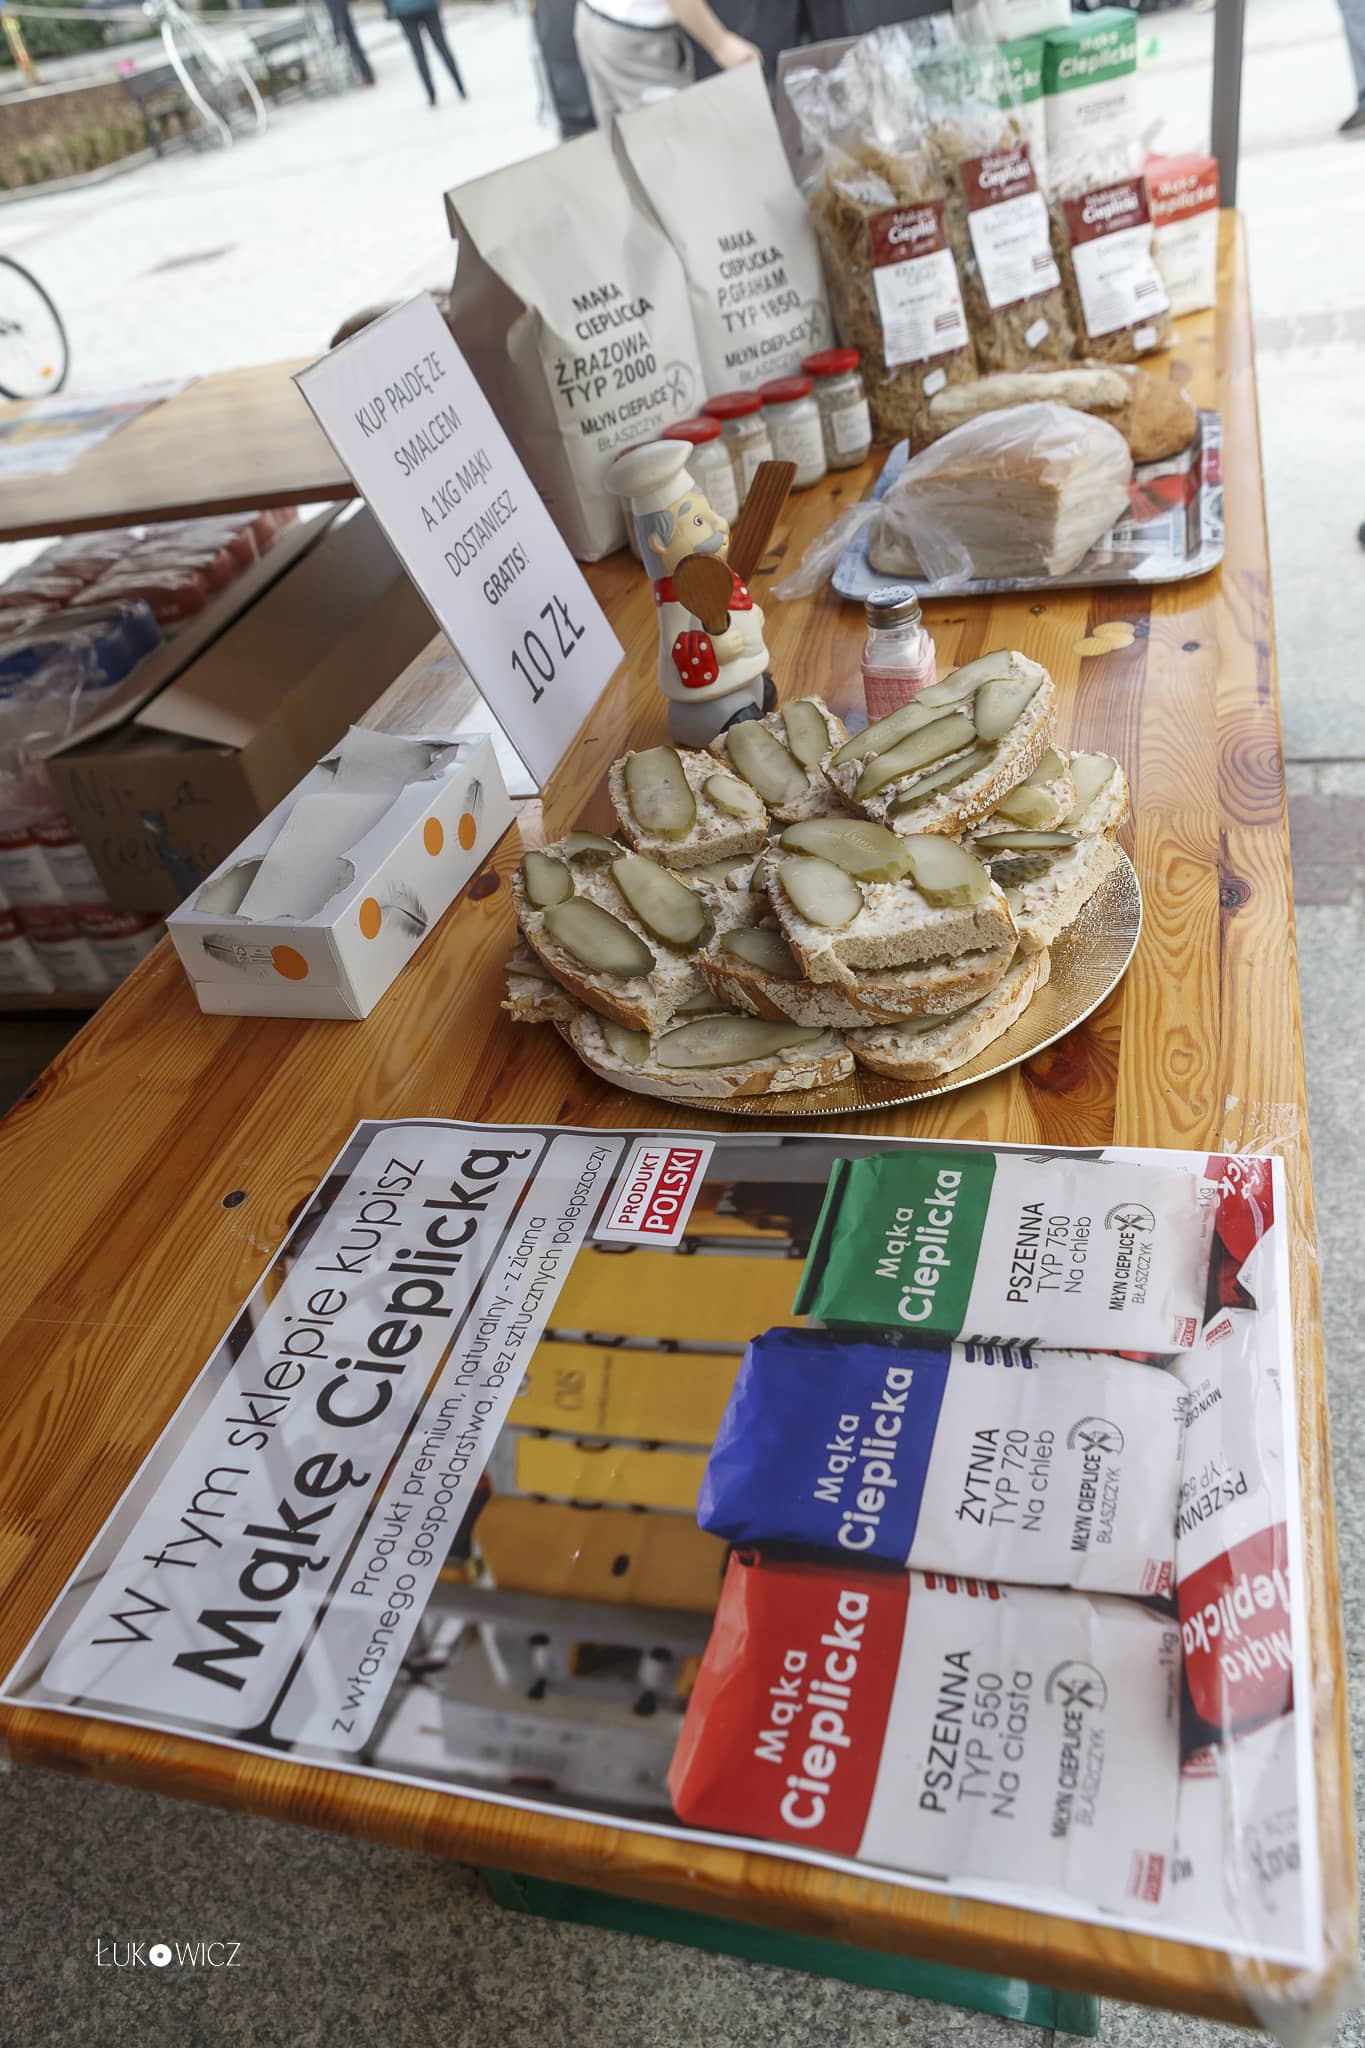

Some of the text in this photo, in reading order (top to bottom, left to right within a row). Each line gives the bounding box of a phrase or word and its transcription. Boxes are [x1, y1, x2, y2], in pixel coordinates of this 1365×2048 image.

[575, 297, 655, 341] CIEPLICKA
[721, 306, 757, 333] TYP
[354, 351, 447, 438] KUP PAJDĘ ZE
[559, 354, 656, 408] TYP 2000
[580, 386, 669, 435] MŁYN CIEPLICE
[393, 405, 462, 477] SMALCEM
[420, 448, 494, 532] A 1KG MĄKI
[444, 489, 518, 577] DOSTANIESZ
[482, 542, 530, 606] GRATIS!
[511, 595, 585, 704] 10 ZŁ
[619, 1152, 661, 1225] PRODUKT
[645, 1149, 698, 1231] POLSKI
[504, 1271, 521, 1282] z
[508, 1216, 547, 1270] ziarna
[875, 1207, 914, 1279] Mąka
[897, 1168, 963, 1322] Cieplicka
[1006, 1202, 1045, 1303] PSZENNA
[1036, 1215, 1071, 1295] TYP 750
[1064, 1216, 1092, 1294] Na chleb
[1109, 1232, 1135, 1311] MŁYN CIEPLICE
[1131, 1242, 1153, 1304] BŁASZCZYK
[454, 1295, 513, 1386] naturalny
[91, 1158, 424, 1646] W tym sklepie kupisz
[172, 1148, 531, 1692] Mąkę Cieplicką
[331, 1145, 613, 1734] z własnego gospodarstwa, bez sztucznych polepszaczy
[404, 1393, 466, 1496] premium,
[814, 1414, 860, 1504] Mąka
[837, 1366, 914, 1551] Cieplicka
[956, 1428, 1000, 1526] ŻYTNIA
[989, 1429, 1030, 1527] TYP 720
[1021, 1429, 1055, 1532] Na chleb
[1071, 1454, 1101, 1552] MŁYN CIEPLICE
[1096, 1466, 1121, 1544] BŁASZCZYK
[351, 1501, 413, 1597] Produkt
[1182, 1567, 1291, 1655] ieplicka
[754, 1650, 808, 1764] Mąka
[780, 1589, 870, 1829] Cieplicka
[919, 1649, 972, 1814] PSZENNA
[957, 1672, 1004, 1803] TYP 550
[990, 1670, 1033, 1821] Na ciasta
[1059, 1710, 1083, 1790] CIEPLICE
